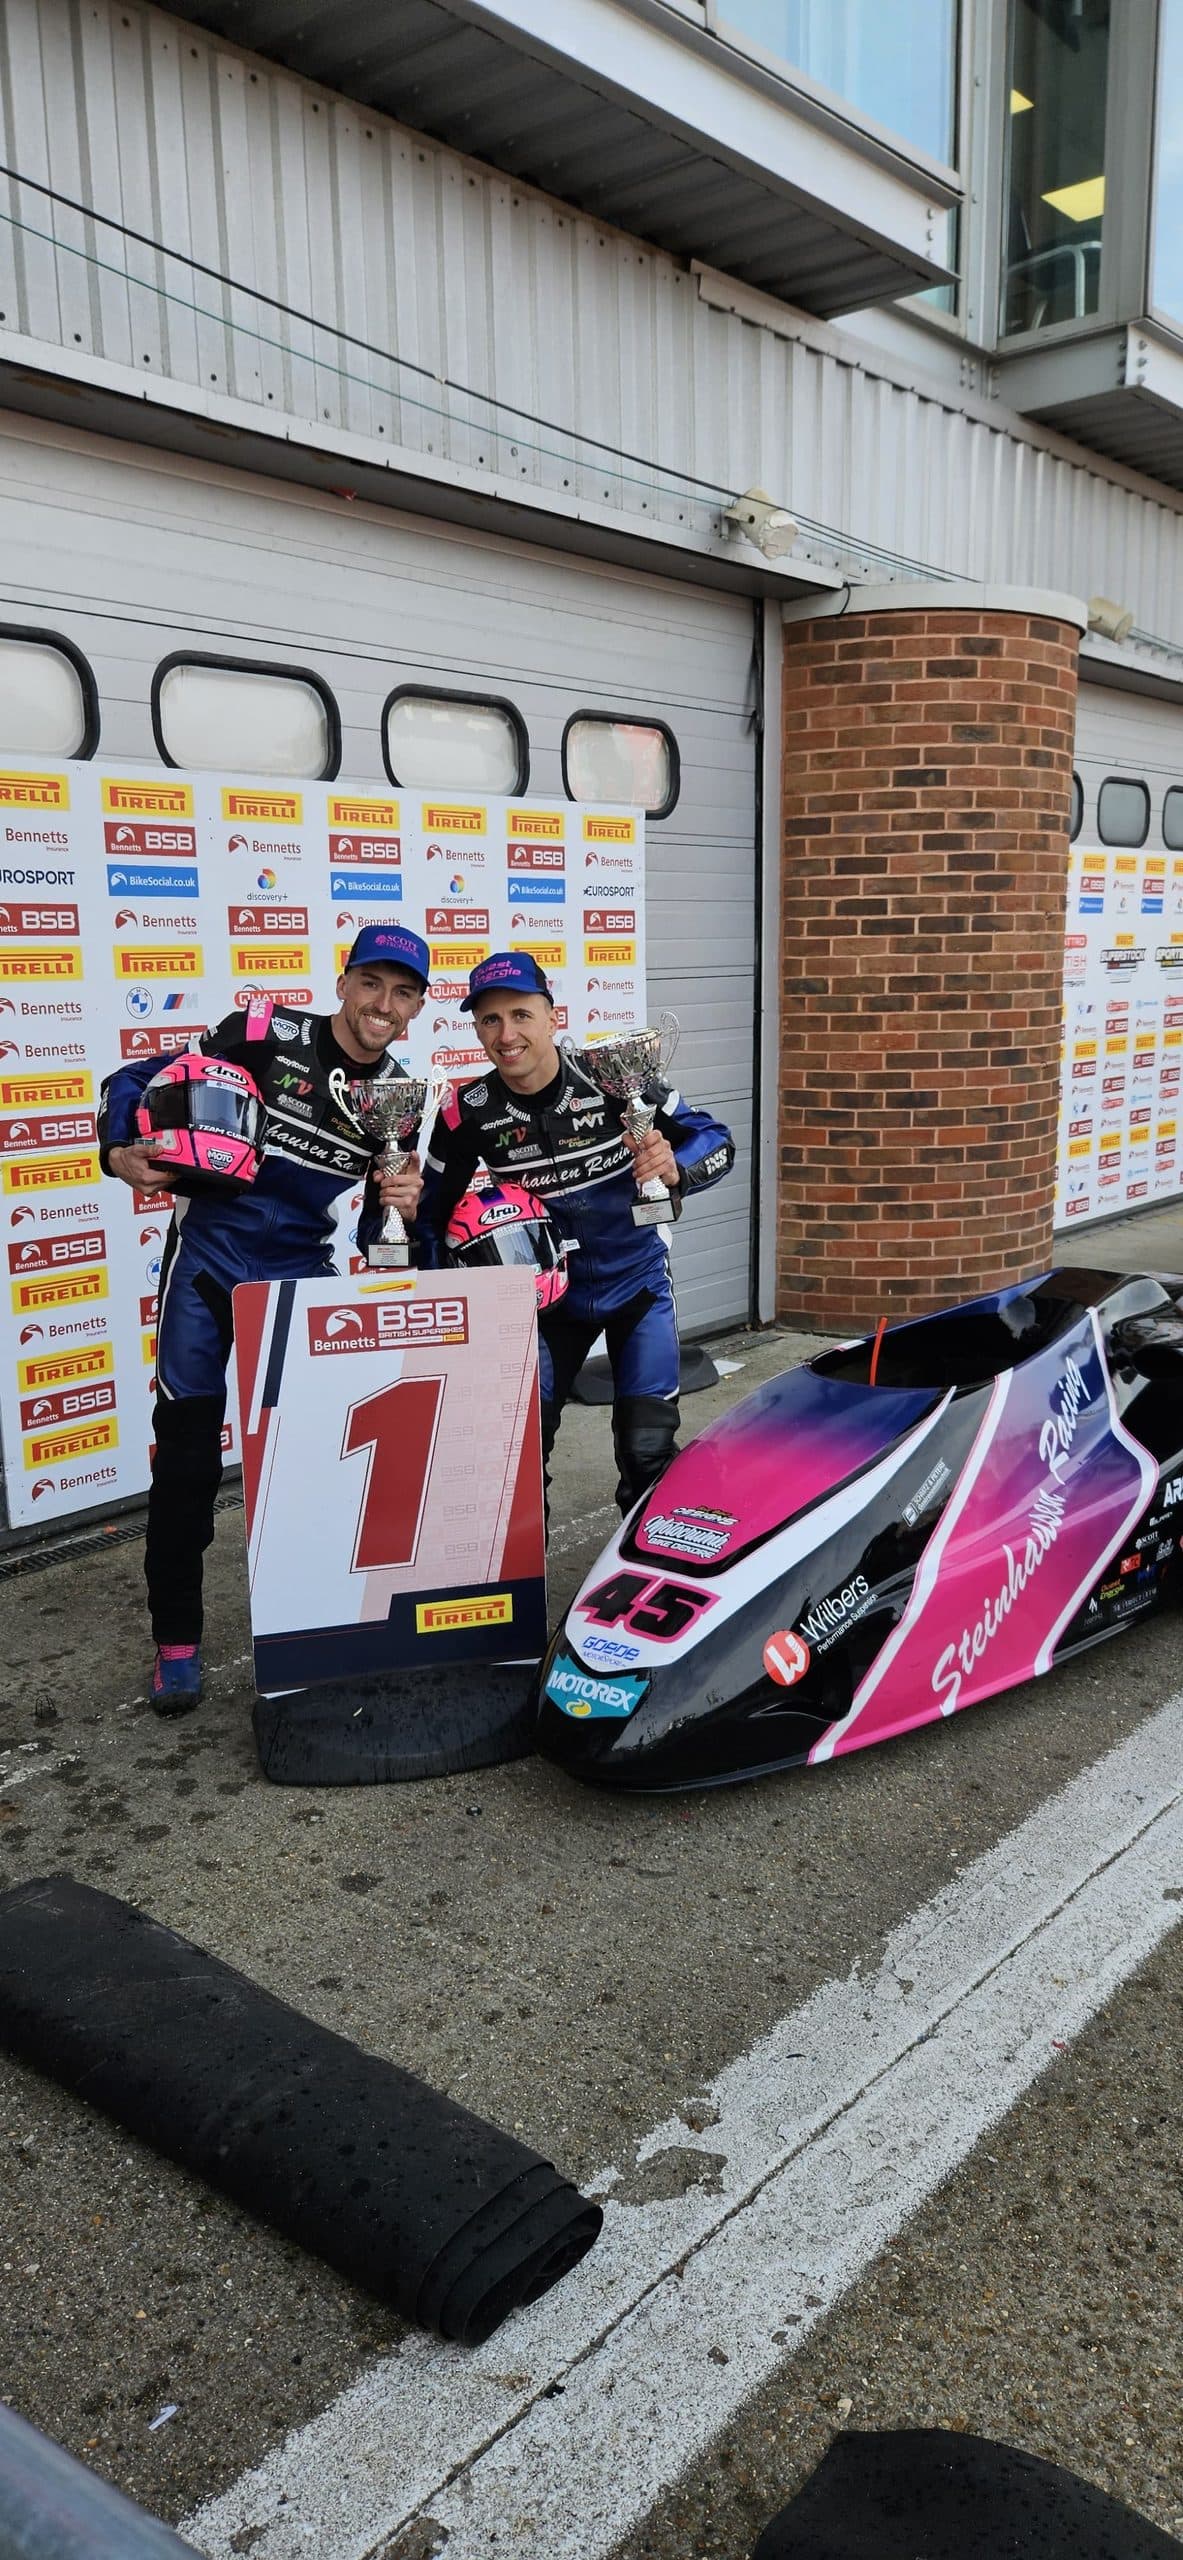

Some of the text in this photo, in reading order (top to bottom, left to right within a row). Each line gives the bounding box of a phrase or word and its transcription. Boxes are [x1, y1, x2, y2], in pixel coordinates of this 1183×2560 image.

[109, 786, 186, 812] PIRELLI
[228, 795, 296, 819] PIRELLI
[334, 802, 394, 824] PIRELLI
[427, 809, 482, 831] PIRELLI
[511, 815, 560, 835] PIRELLI
[586, 820, 631, 840] PIRELLI
[5, 827, 68, 845] Bennetts
[110, 831, 193, 852] Bennetts BSB
[252, 840, 302, 855] Bennetts
[333, 843, 398, 861] Bennetts BSB
[445, 849, 485, 862] Bennetts
[532, 850, 564, 866] BSB
[601, 856, 633, 868] Bennetts
[129, 875, 196, 888] BikeSocial.co.uk
[347, 880, 400, 892] BikeSocial.co.uk
[586, 885, 635, 898] EUROSPORT
[246, 892, 288, 903] discovery+
[440, 896, 474, 905] discovery+
[21, 910, 76, 930] BSB
[142, 914, 197, 929] Bennetts
[233, 913, 305, 934] Bennetts BSB
[453, 914, 487, 929] BSB
[528, 917, 564, 929] Bennetts
[605, 914, 633, 929] BSB
[121, 952, 196, 973] PIRELLI
[237, 951, 304, 970] PIRELLI
[588, 945, 631, 962] PIRELLI
[431, 985, 470, 999] QUATT
[602, 980, 635, 992] Bennetts
[21, 1001, 82, 1016] Bennetts
[602, 1011, 635, 1022] Bennetts
[25, 1043, 86, 1058] Bennetts
[126, 1046, 157, 1056] Bennetts
[1, 1078, 84, 1104] PIRELLI
[554, 1085, 575, 1115] YAMAHA
[287, 1096, 313, 1112] SCOTT
[504, 1101, 532, 1123] YAMAHA
[3, 1119, 93, 1149] Bennetts BSB
[207, 1150, 234, 1163] MOTO
[515, 1143, 539, 1155] SCOTT
[10, 1158, 92, 1187] PIRELLI
[40, 1202, 99, 1221] Bennetts
[138, 1200, 168, 1211] Bennetts
[482, 1204, 518, 1225] Arai
[15, 1237, 103, 1270] Bennetts BSB
[20, 1274, 100, 1307] PIRELLI
[48, 1315, 107, 1338] Bennetts
[314, 1301, 464, 1351] Bennetts BSB
[378, 1326, 465, 1339] BRITISH SUPERBIKES
[26, 1350, 106, 1385] PIRELLI
[27, 1391, 112, 1427] Bennetts BSB
[32, 1425, 111, 1463] PIRELLI
[60, 1465, 117, 1491] Bennetts
[340, 1374, 447, 1574] 1
[1163, 1474, 1183, 1508] AR
[932, 1355, 1092, 1717] Steinhausen Racing
[424, 1600, 505, 1628] PIRELLI
[578, 1571, 717, 1641] 45
[799, 1574, 870, 1642] Wilbers
[816, 1592, 880, 1656] Performance Suspension
[547, 1671, 635, 1712] MOTOREX
